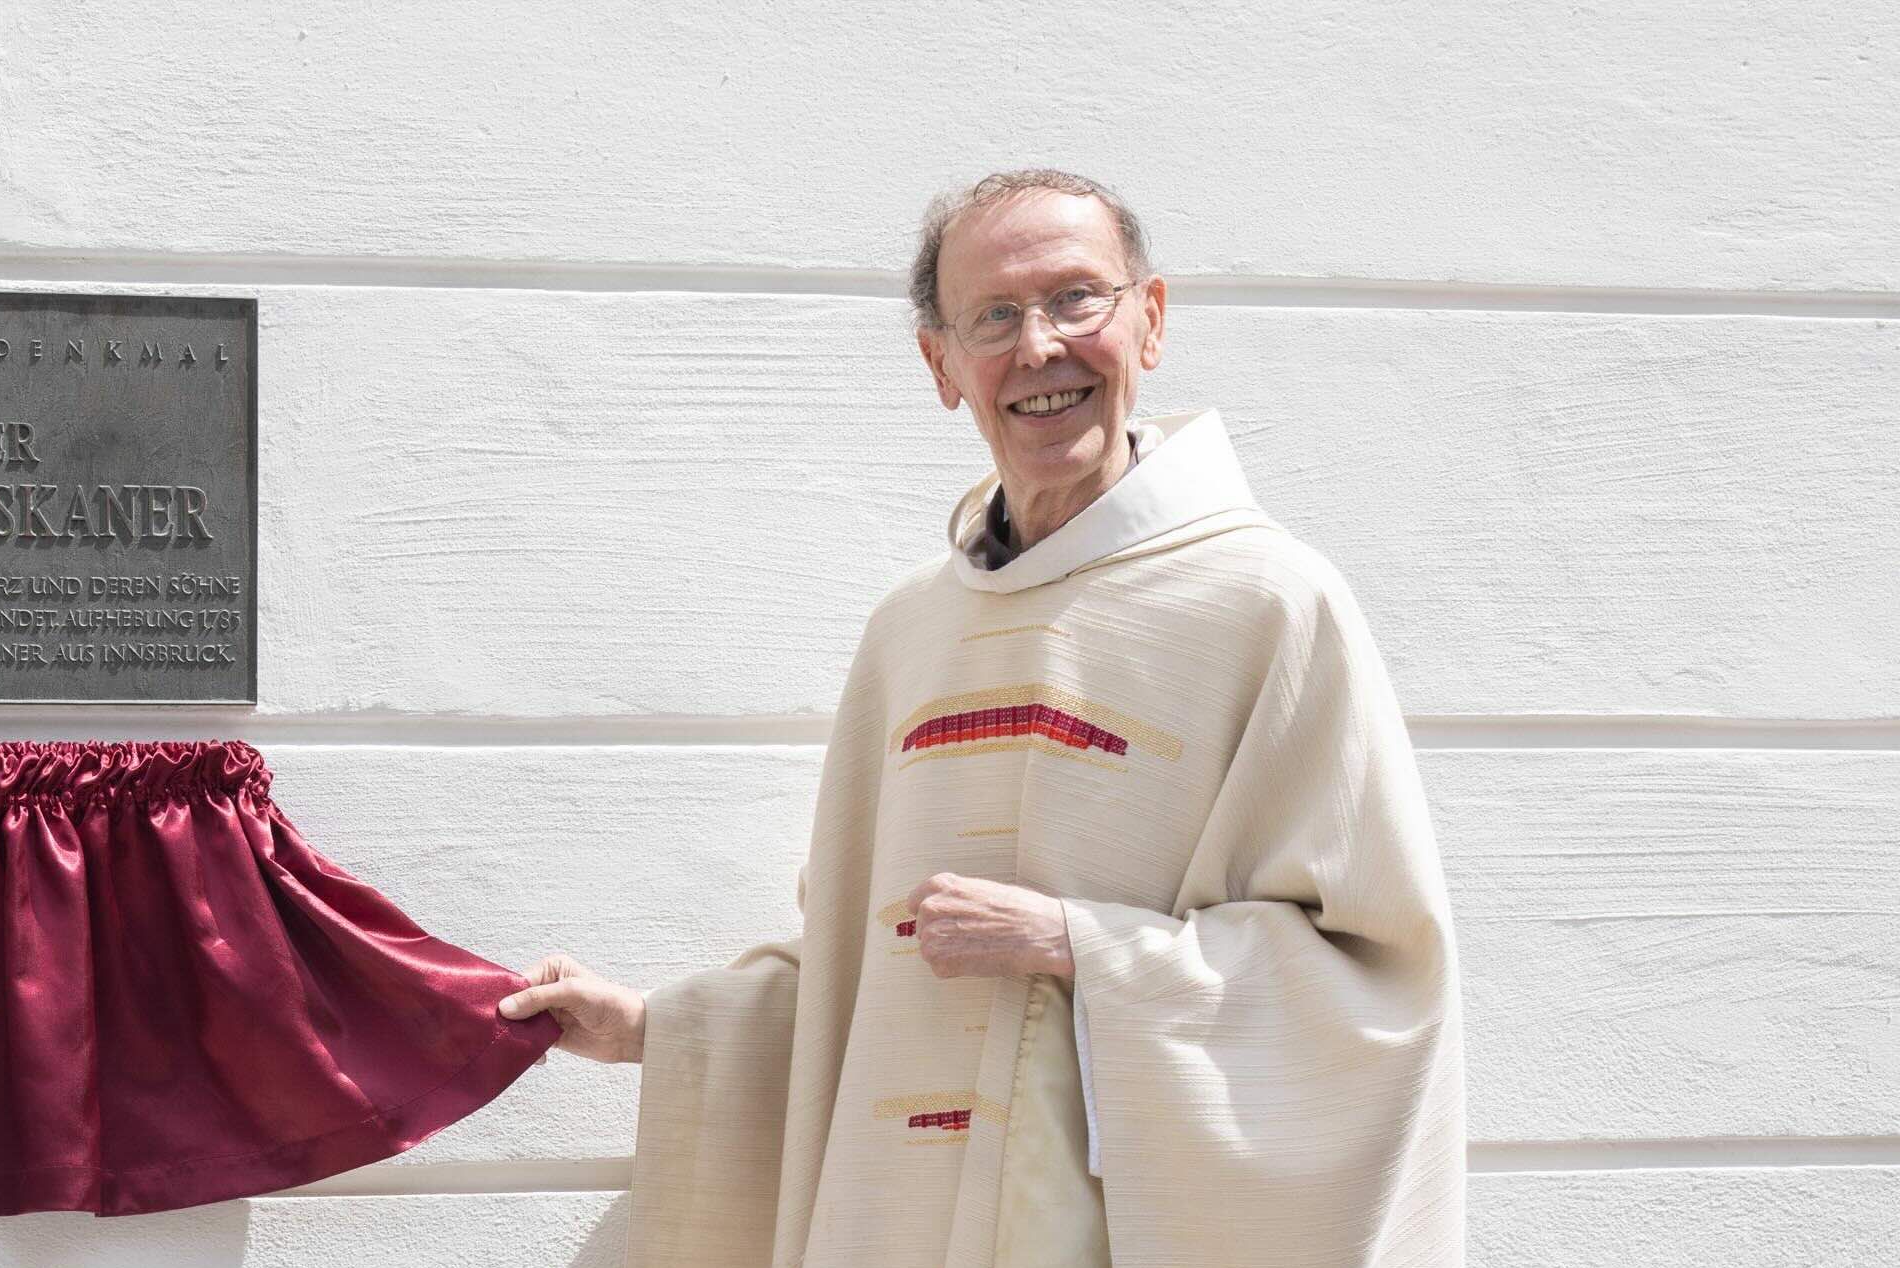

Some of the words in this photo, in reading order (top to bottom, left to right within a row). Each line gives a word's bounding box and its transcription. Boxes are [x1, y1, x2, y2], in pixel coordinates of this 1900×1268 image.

[30, 576, 83, 595] UND
[91, 576, 162, 597] DEREN
[169, 572, 241, 595] SÖHNE
[62, 608, 194, 629] AUFHEBUNG
[57, 643, 95, 663] AUS
